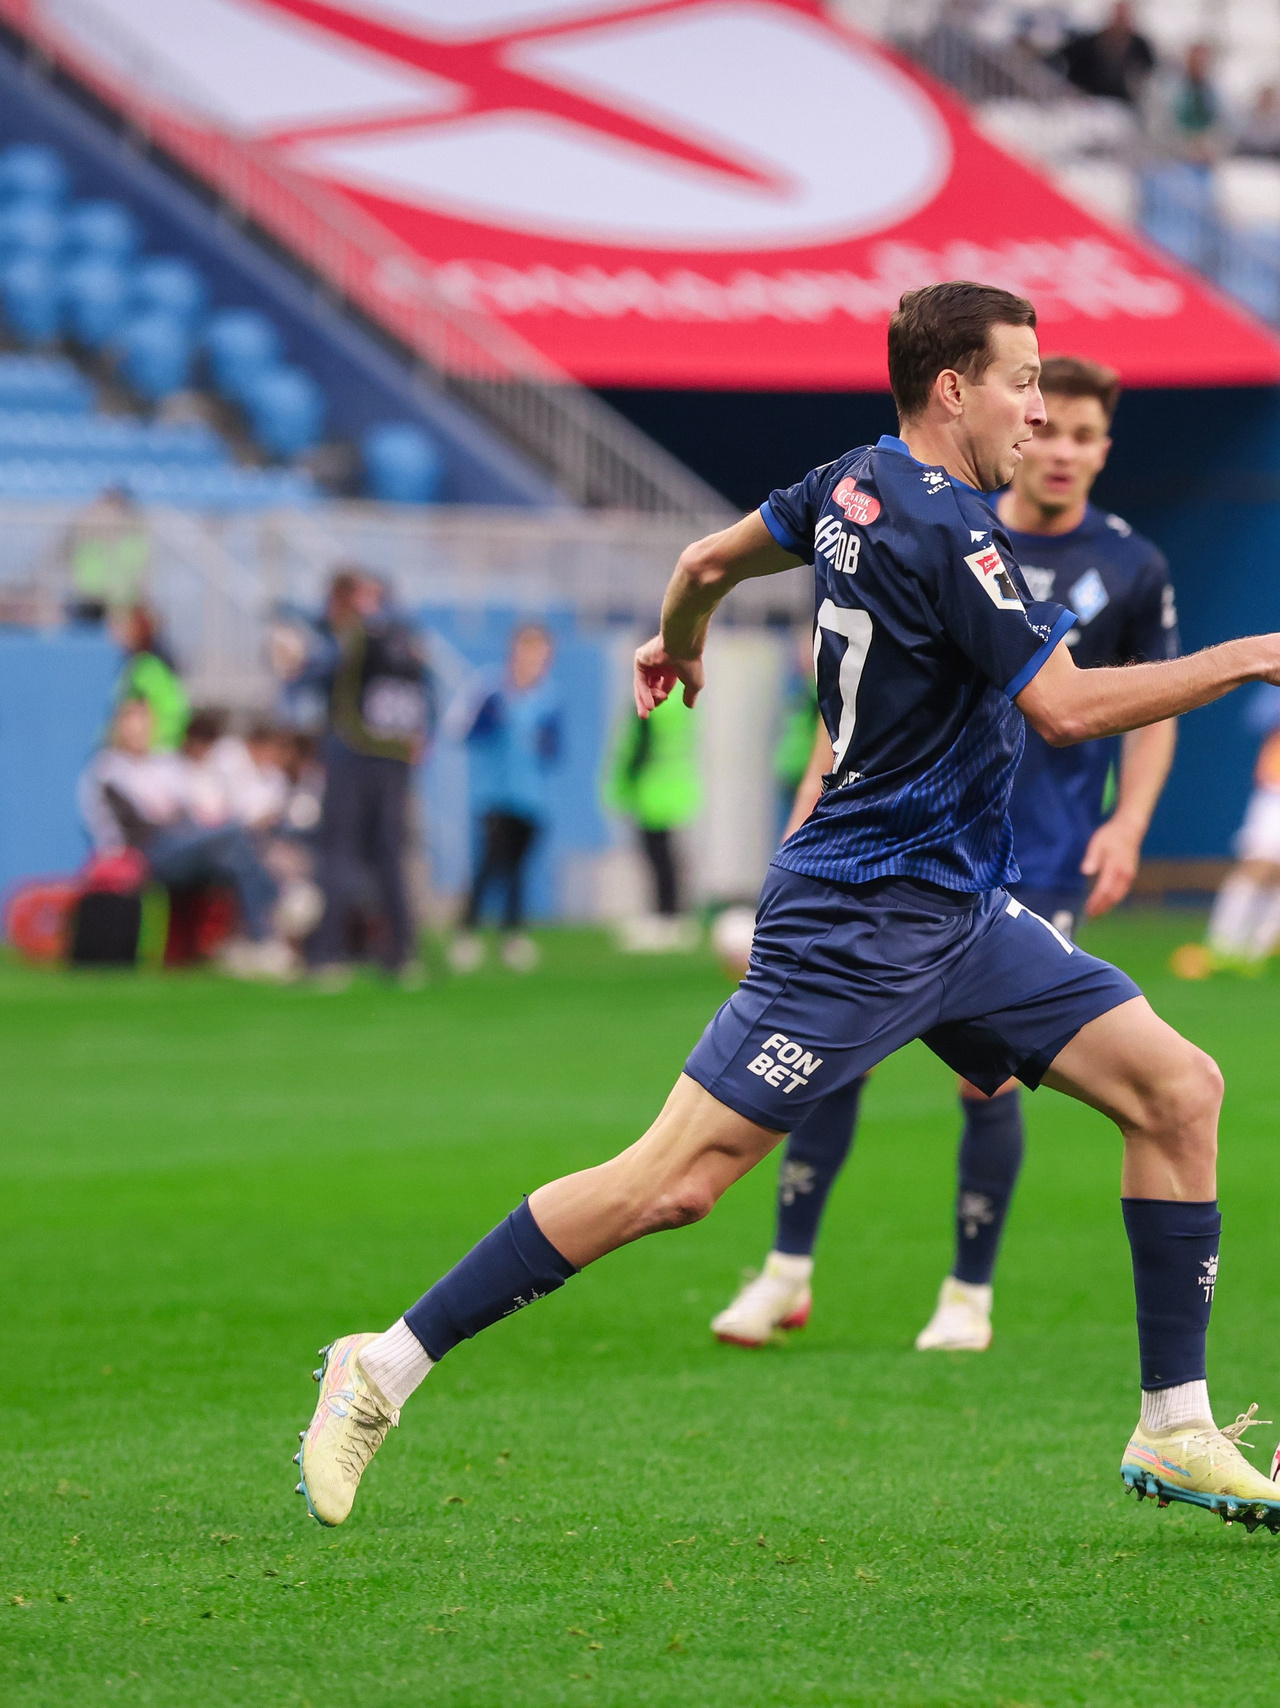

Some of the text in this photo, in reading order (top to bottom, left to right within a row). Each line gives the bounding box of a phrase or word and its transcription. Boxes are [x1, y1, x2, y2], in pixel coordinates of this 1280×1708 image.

[851, 493, 872, 508] БАНК
[746, 1052, 809, 1094] BET
[761, 1033, 824, 1077] FON
